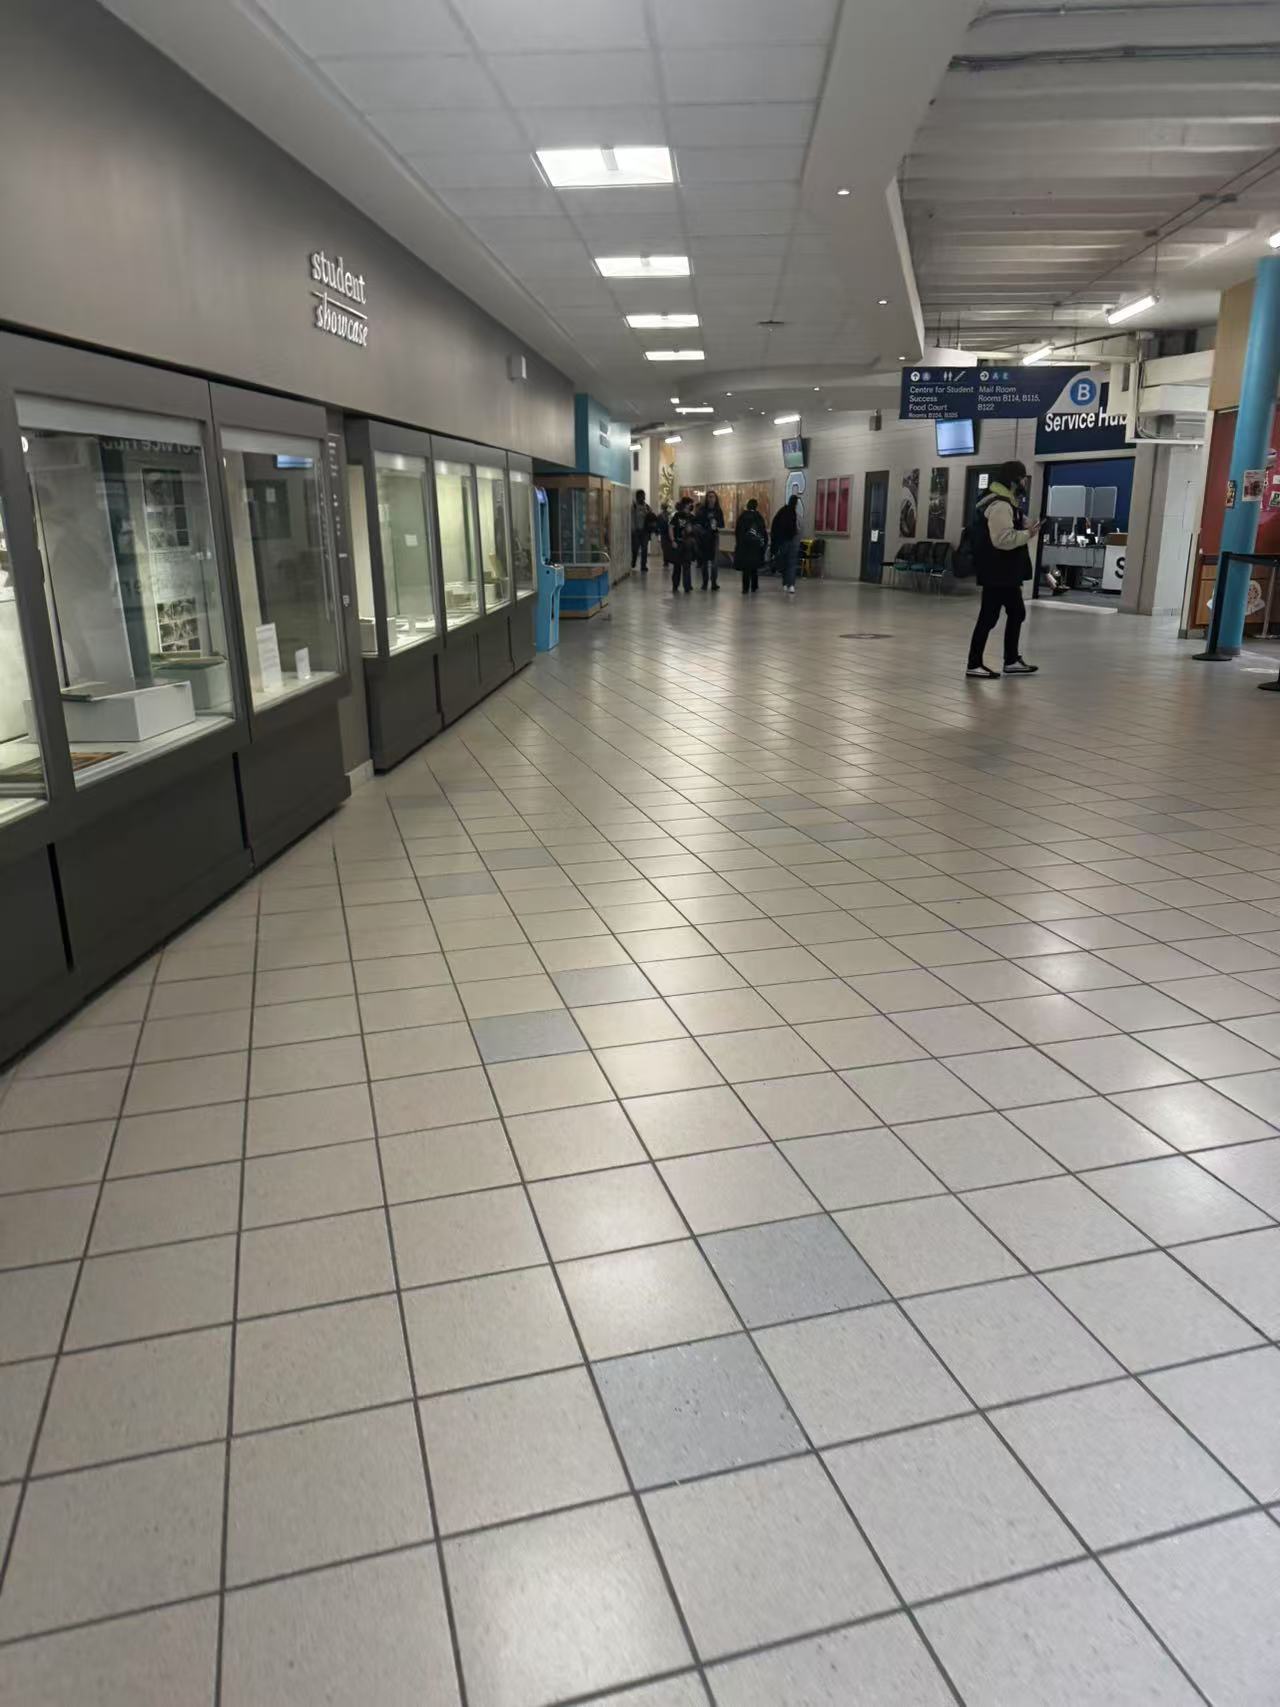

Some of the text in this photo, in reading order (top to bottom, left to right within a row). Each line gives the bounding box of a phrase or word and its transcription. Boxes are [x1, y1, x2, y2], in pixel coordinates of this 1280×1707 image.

[311, 250, 367, 305] student
[315, 292, 369, 347] showcase
[909, 386, 934, 394] Centre
[1077, 383, 1091, 401] B
[977, 403, 995, 411] B122
[1045, 412, 1096, 433] Service
